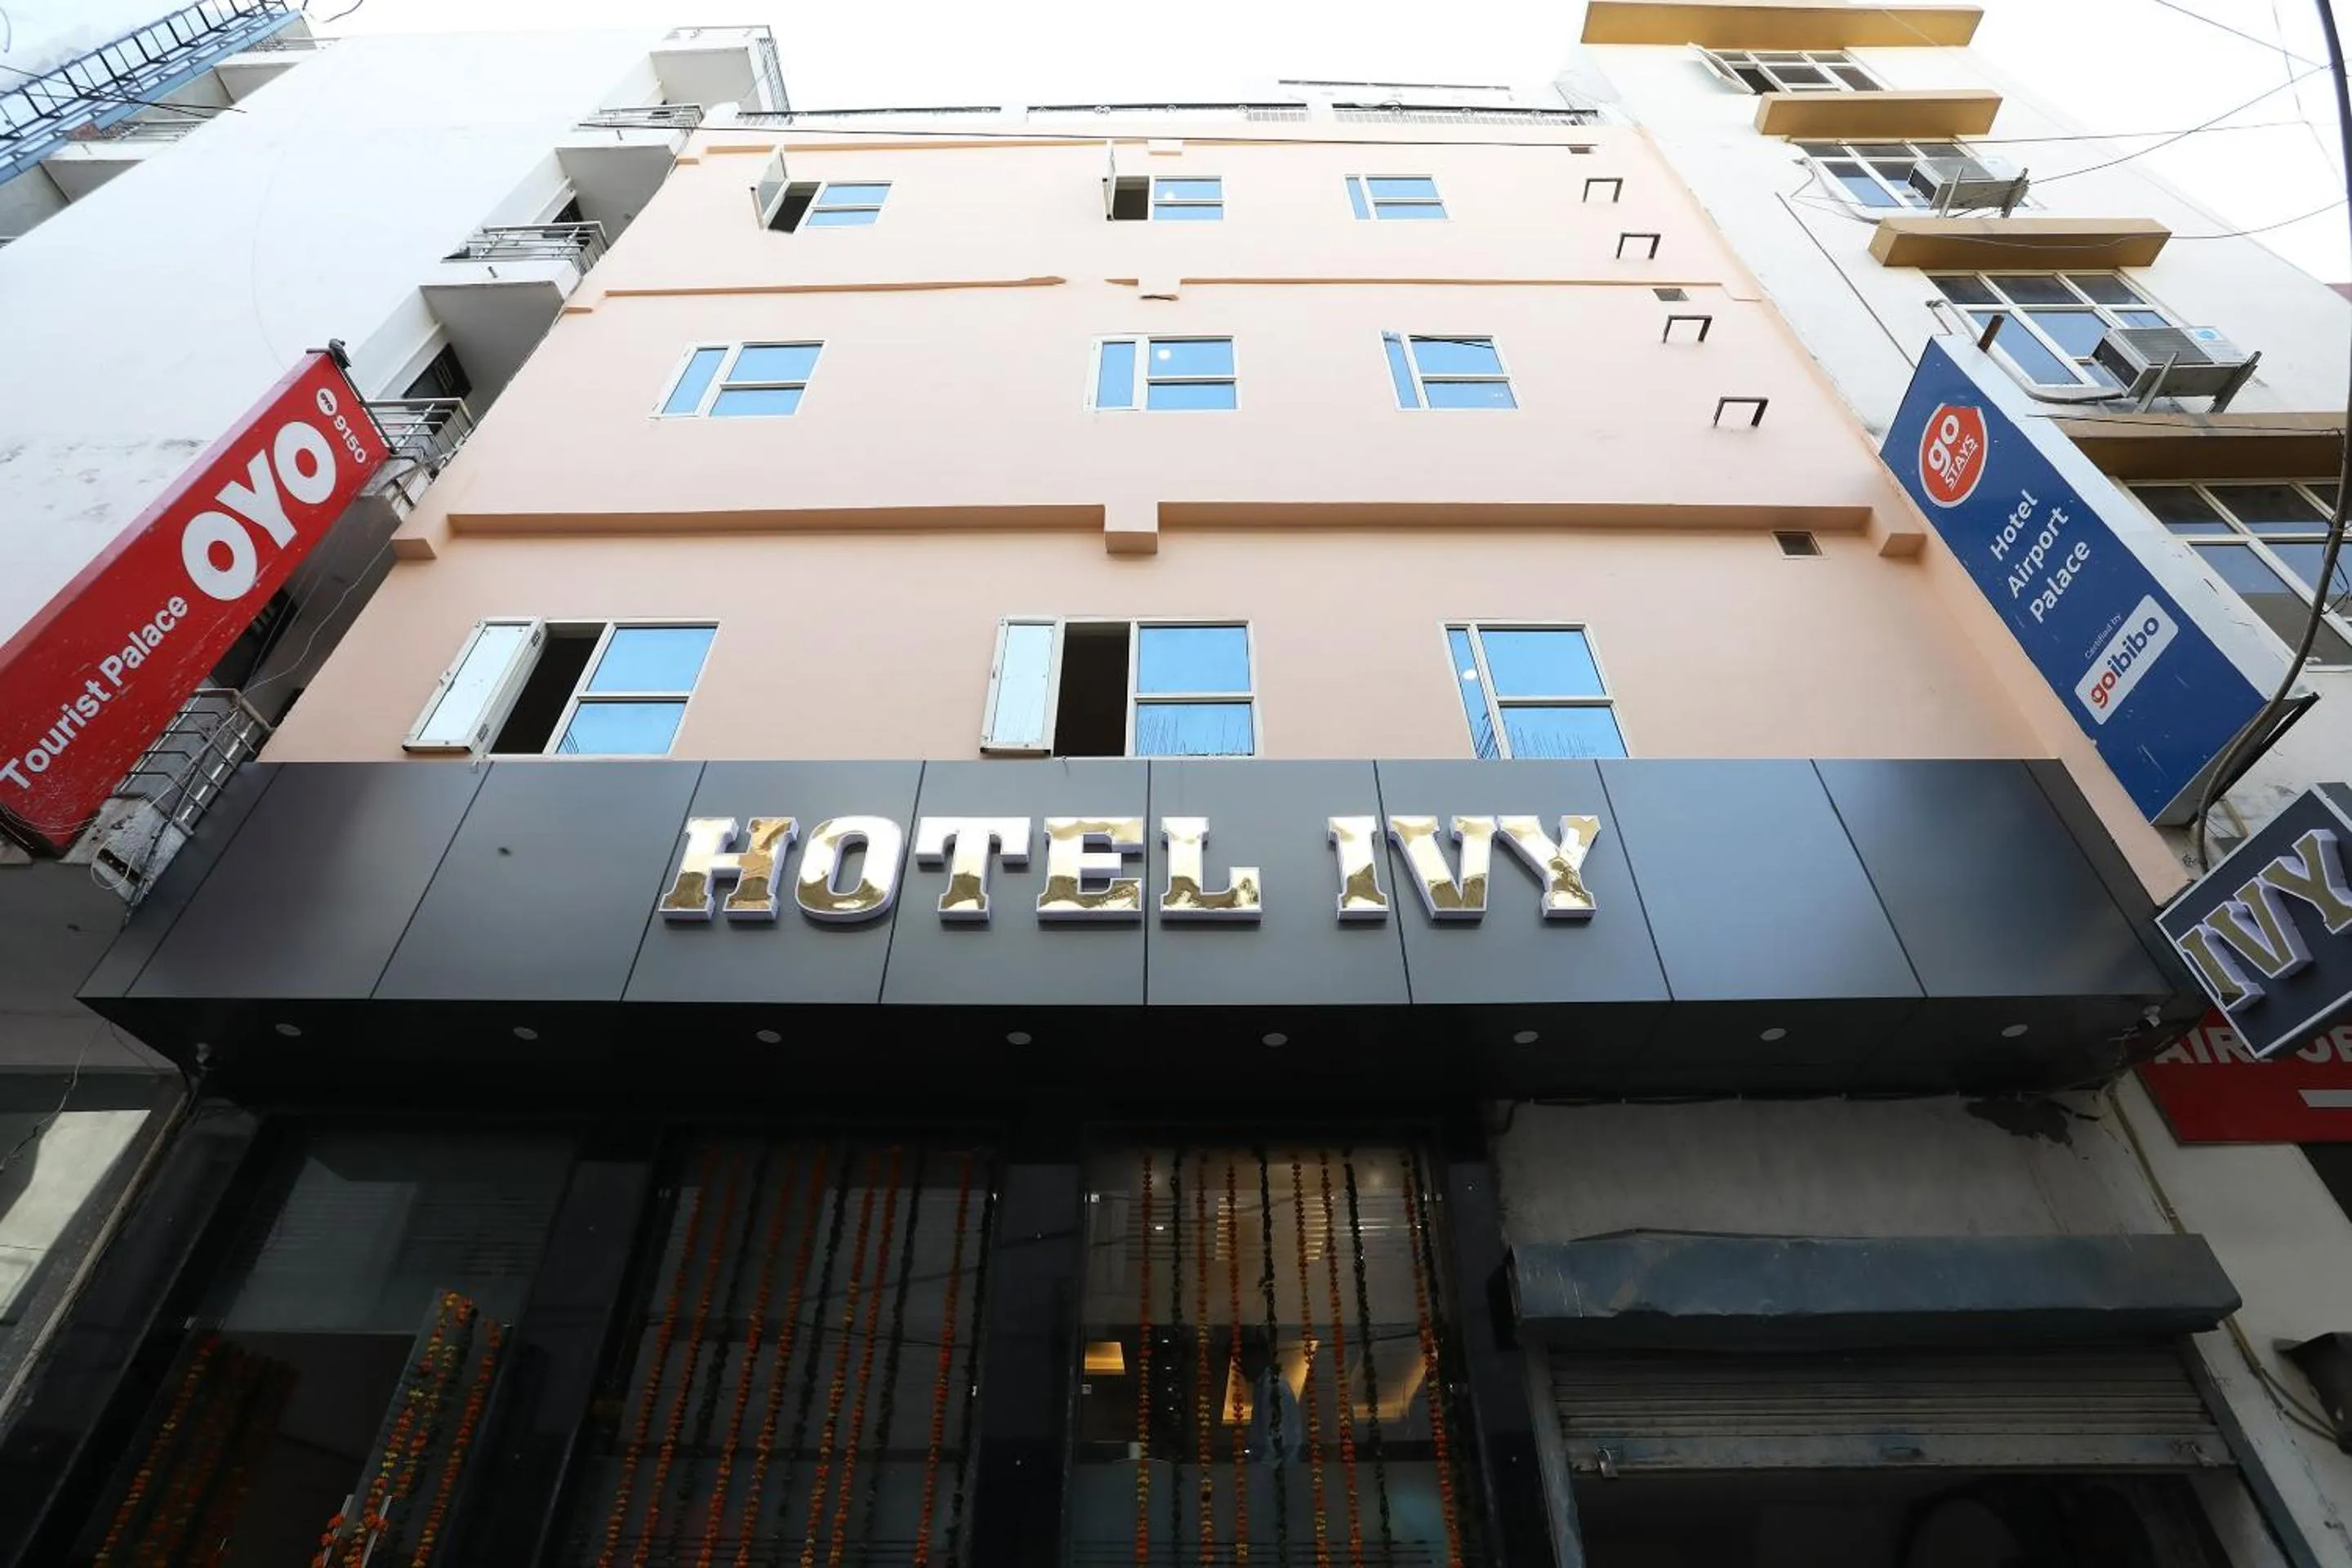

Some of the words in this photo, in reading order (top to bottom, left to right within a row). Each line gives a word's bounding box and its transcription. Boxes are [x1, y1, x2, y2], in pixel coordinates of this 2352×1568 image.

[333, 415, 366, 463] 9150
[1928, 414, 1959, 477] go
[1945, 434, 1977, 491] STAYS
[181, 421, 336, 600] OYO
[1989, 489, 2038, 561] Hotel
[2007, 506, 2069, 599] Airport
[2029, 541, 2091, 623] Palace
[0, 679, 112, 790] Tourist
[99, 595, 189, 687] Palace
[2091, 617, 2158, 709] goibibo
[658, 815, 1262, 924] HOTEL
[1327, 815, 1601, 921] IVY
[2176, 829, 2352, 1011] IVY
